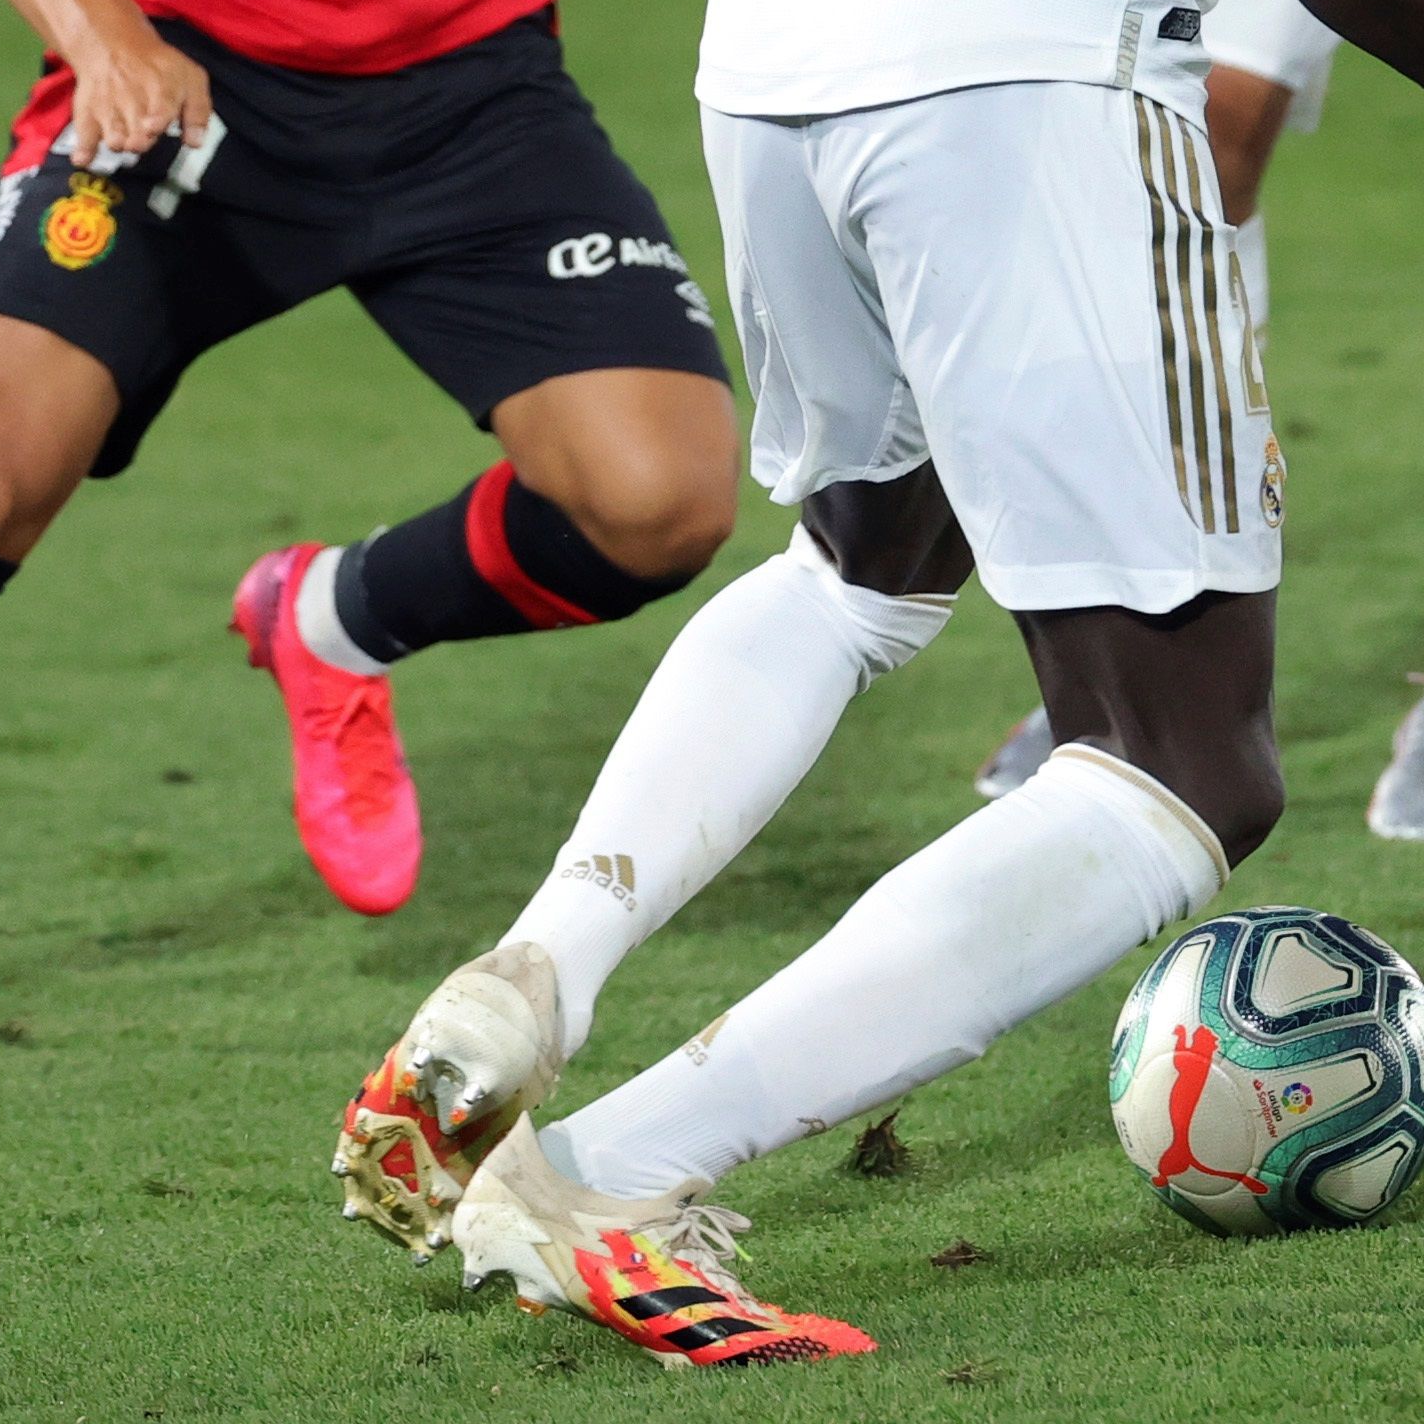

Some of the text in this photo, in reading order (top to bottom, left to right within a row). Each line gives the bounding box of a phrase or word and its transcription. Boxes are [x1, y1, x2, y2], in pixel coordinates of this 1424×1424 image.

[560, 866, 638, 913] adidas
[1257, 1091, 1278, 1138] Santander
[1268, 1089, 1283, 1123] LaLiga
